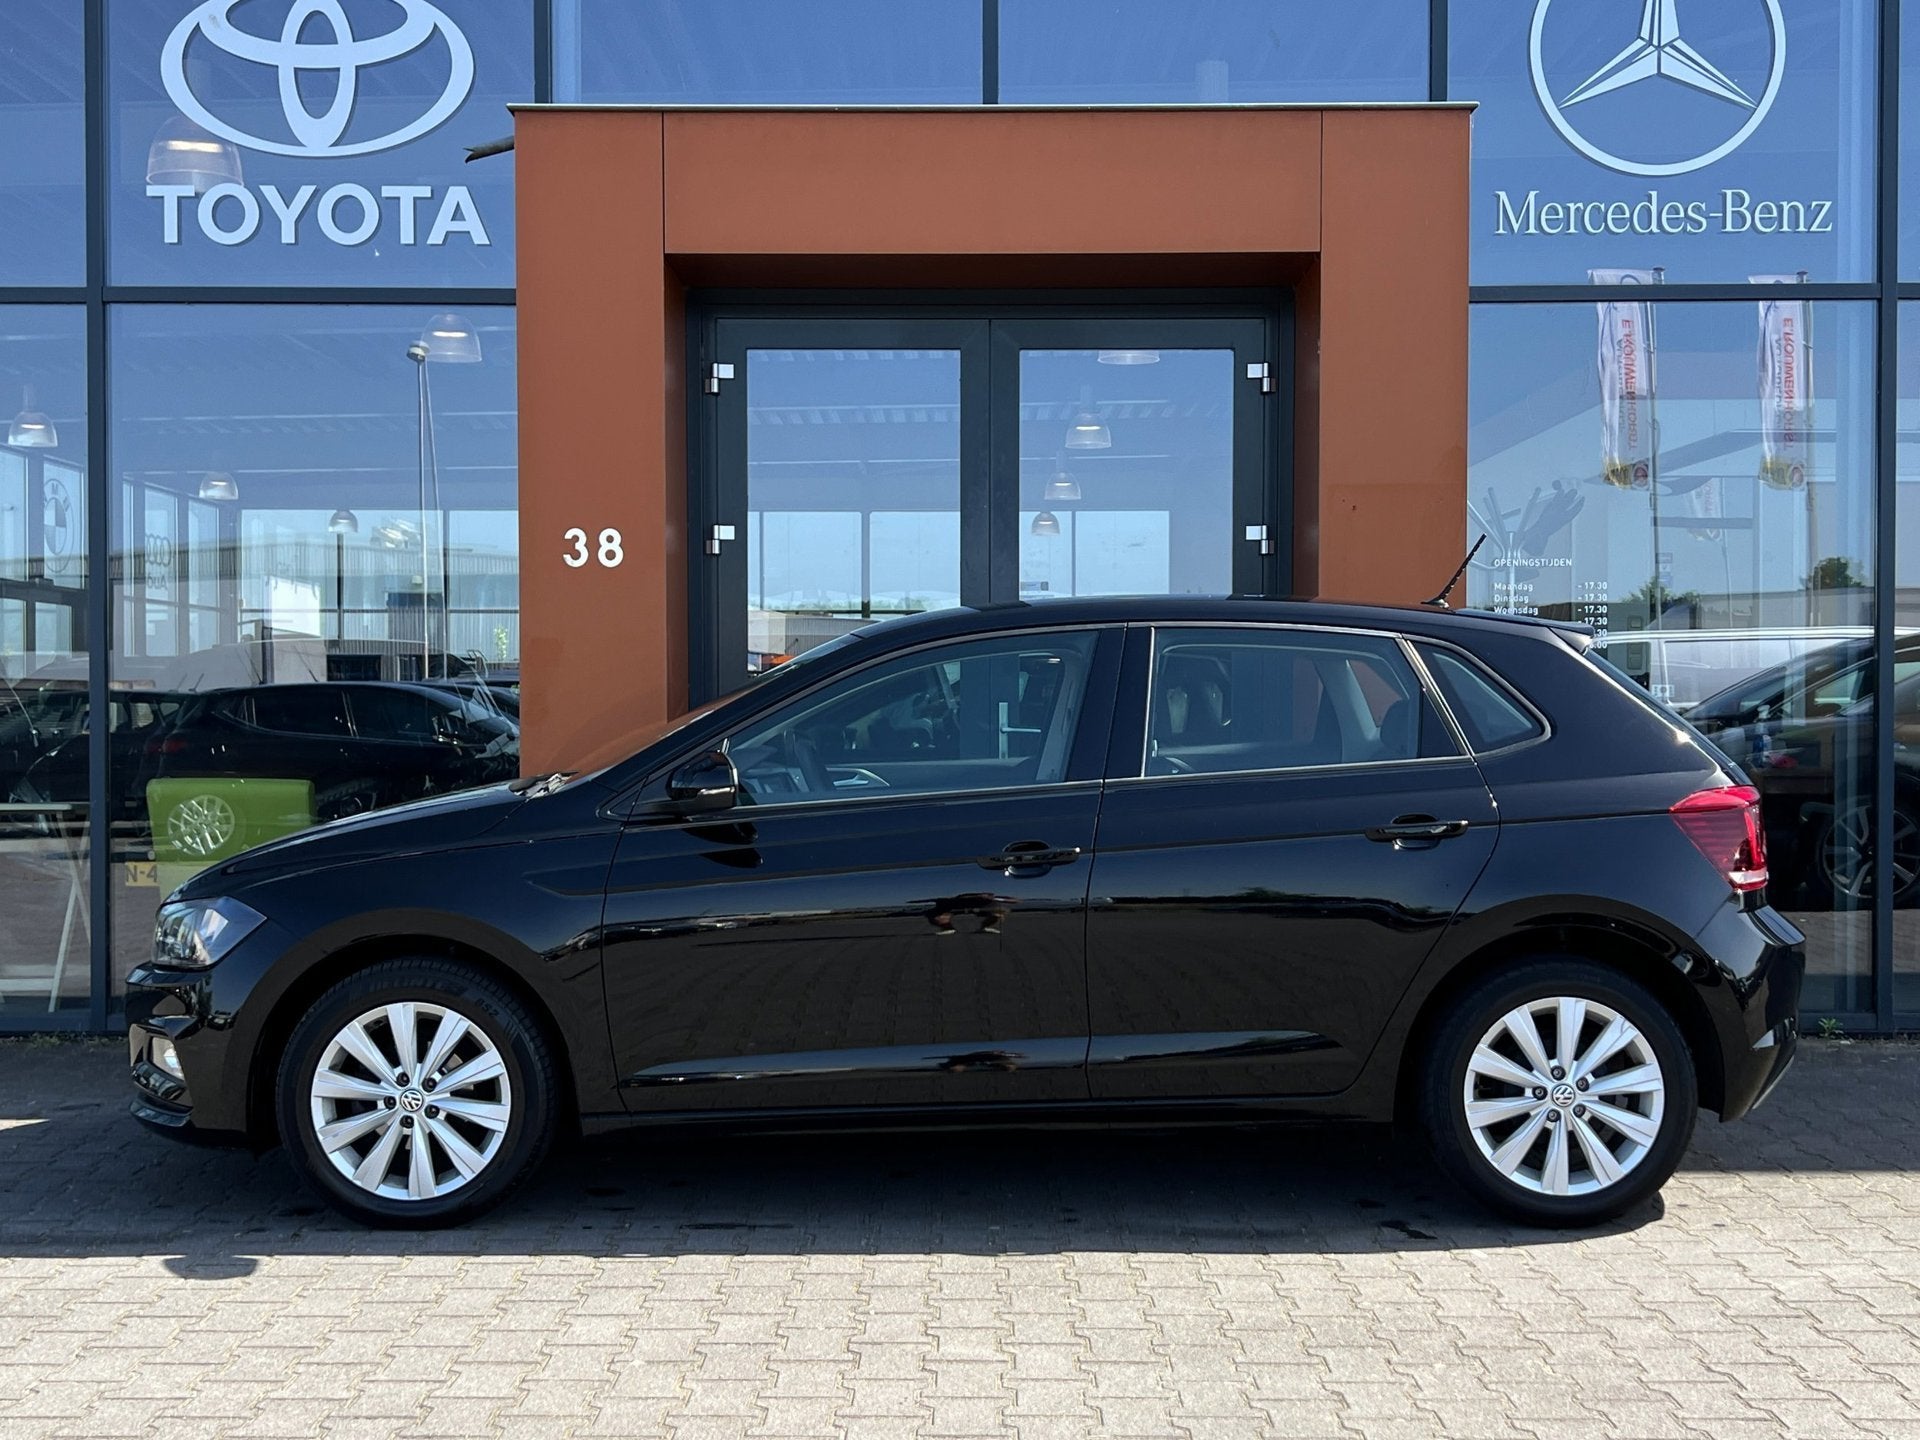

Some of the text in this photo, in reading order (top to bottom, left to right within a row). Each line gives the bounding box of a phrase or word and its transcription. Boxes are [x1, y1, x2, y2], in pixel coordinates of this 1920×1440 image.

[146, 183, 490, 246] TOYOTA
[1495, 189, 1833, 234] Mercedes-Benz
[563, 527, 624, 568] 38
[1494, 558, 1572, 567] OPENINGSTIJDEN
[1494, 582, 1533, 592] Maandag
[1584, 582, 1607, 590] 17.30
[1494, 594, 1529, 604] Dinsdag
[1584, 594, 1607, 602] 17.30
[1493, 606, 1538, 616] Woensdag
[1584, 605, 1607, 614] 17.30
